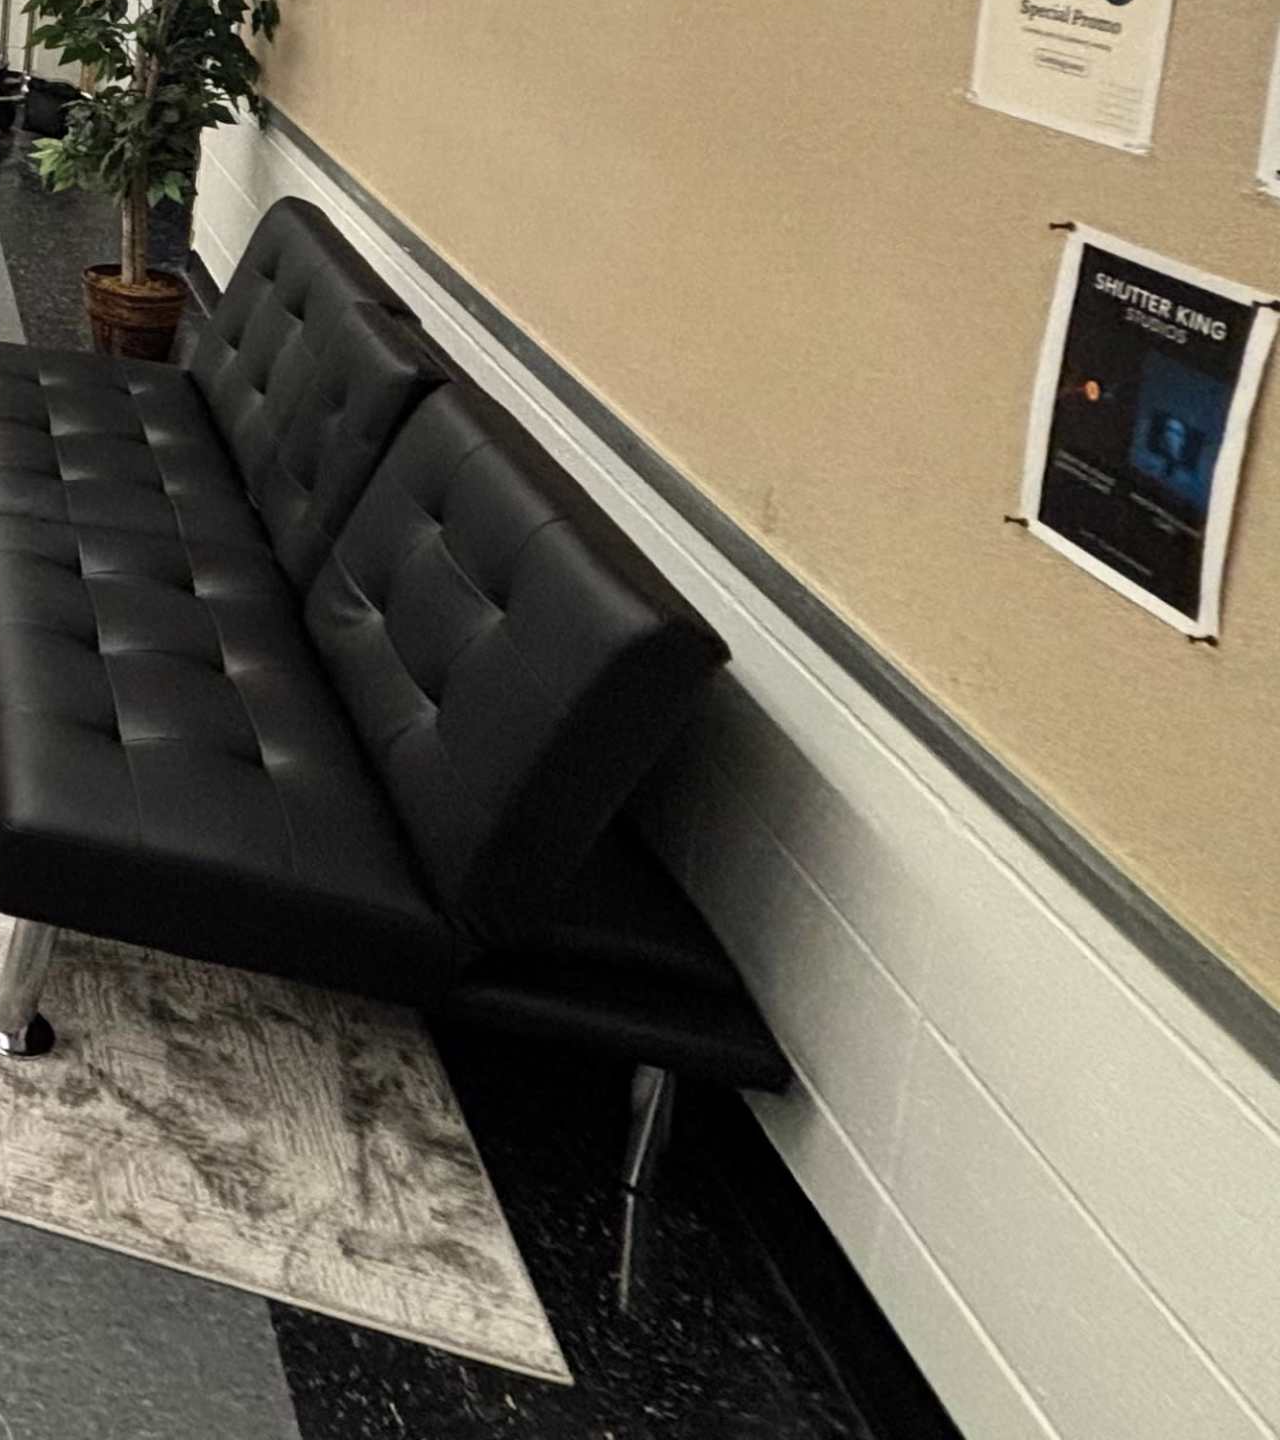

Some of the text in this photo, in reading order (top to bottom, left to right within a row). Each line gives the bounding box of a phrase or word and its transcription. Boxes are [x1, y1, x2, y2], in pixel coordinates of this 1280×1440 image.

[1019, 0, 1122, 34] Special Promo
[1094, 272, 1227, 340] SHUTTER KING
